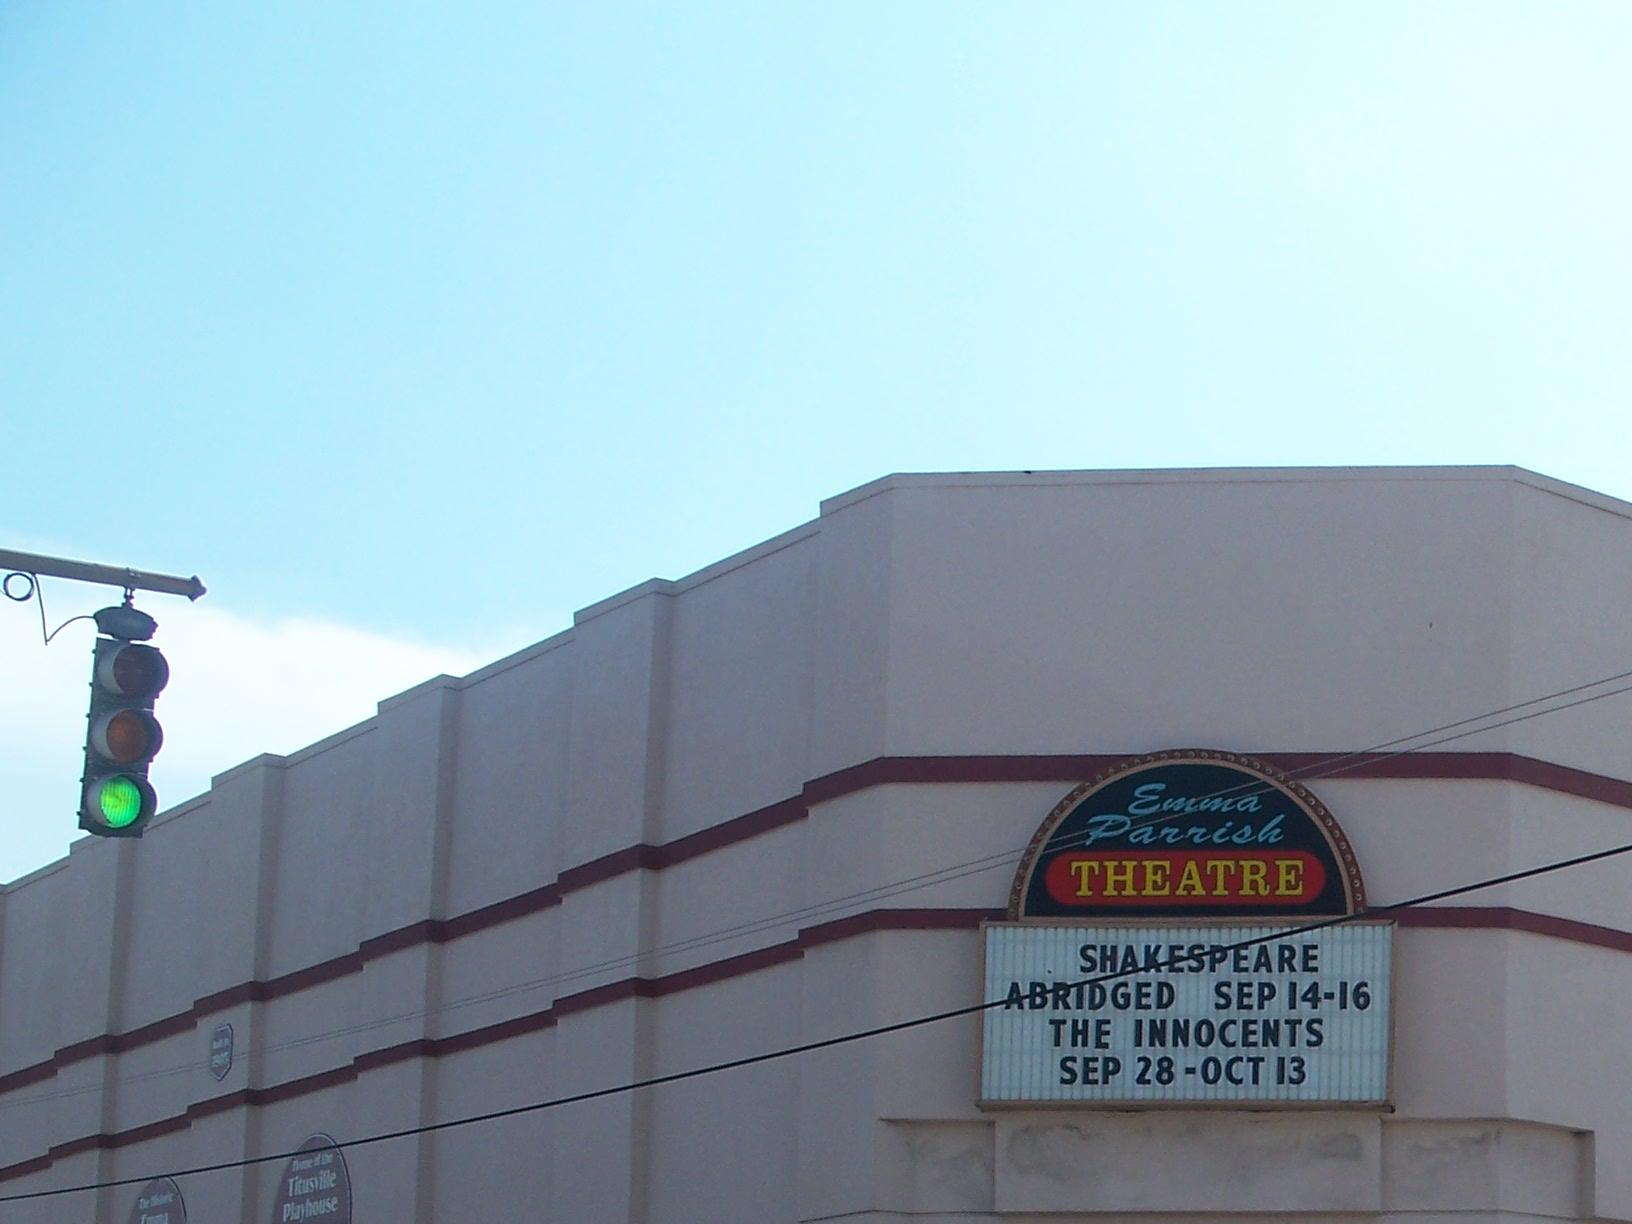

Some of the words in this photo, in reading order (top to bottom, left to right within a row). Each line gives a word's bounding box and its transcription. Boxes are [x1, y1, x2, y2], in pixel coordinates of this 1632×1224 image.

[1128, 783, 1262, 815] Emma
[1087, 814, 1285, 846] Parrish
[1071, 859, 1304, 897] THEATRE
[1079, 944, 1320, 974] SHAKESPEARE
[1005, 981, 1175, 1011] ABRIDGED
[1214, 981, 1276, 1011] SEP
[1289, 981, 1371, 1011] 14-16
[1050, 1018, 1111, 1049] THE
[1134, 1018, 1324, 1047] INNOCENTS
[1059, 1056, 1121, 1085] SEP
[1277, 1056, 1306, 1085] 13
[288, 1170, 336, 1197] Titusville
[282, 1195, 338, 1222] Playhouse
